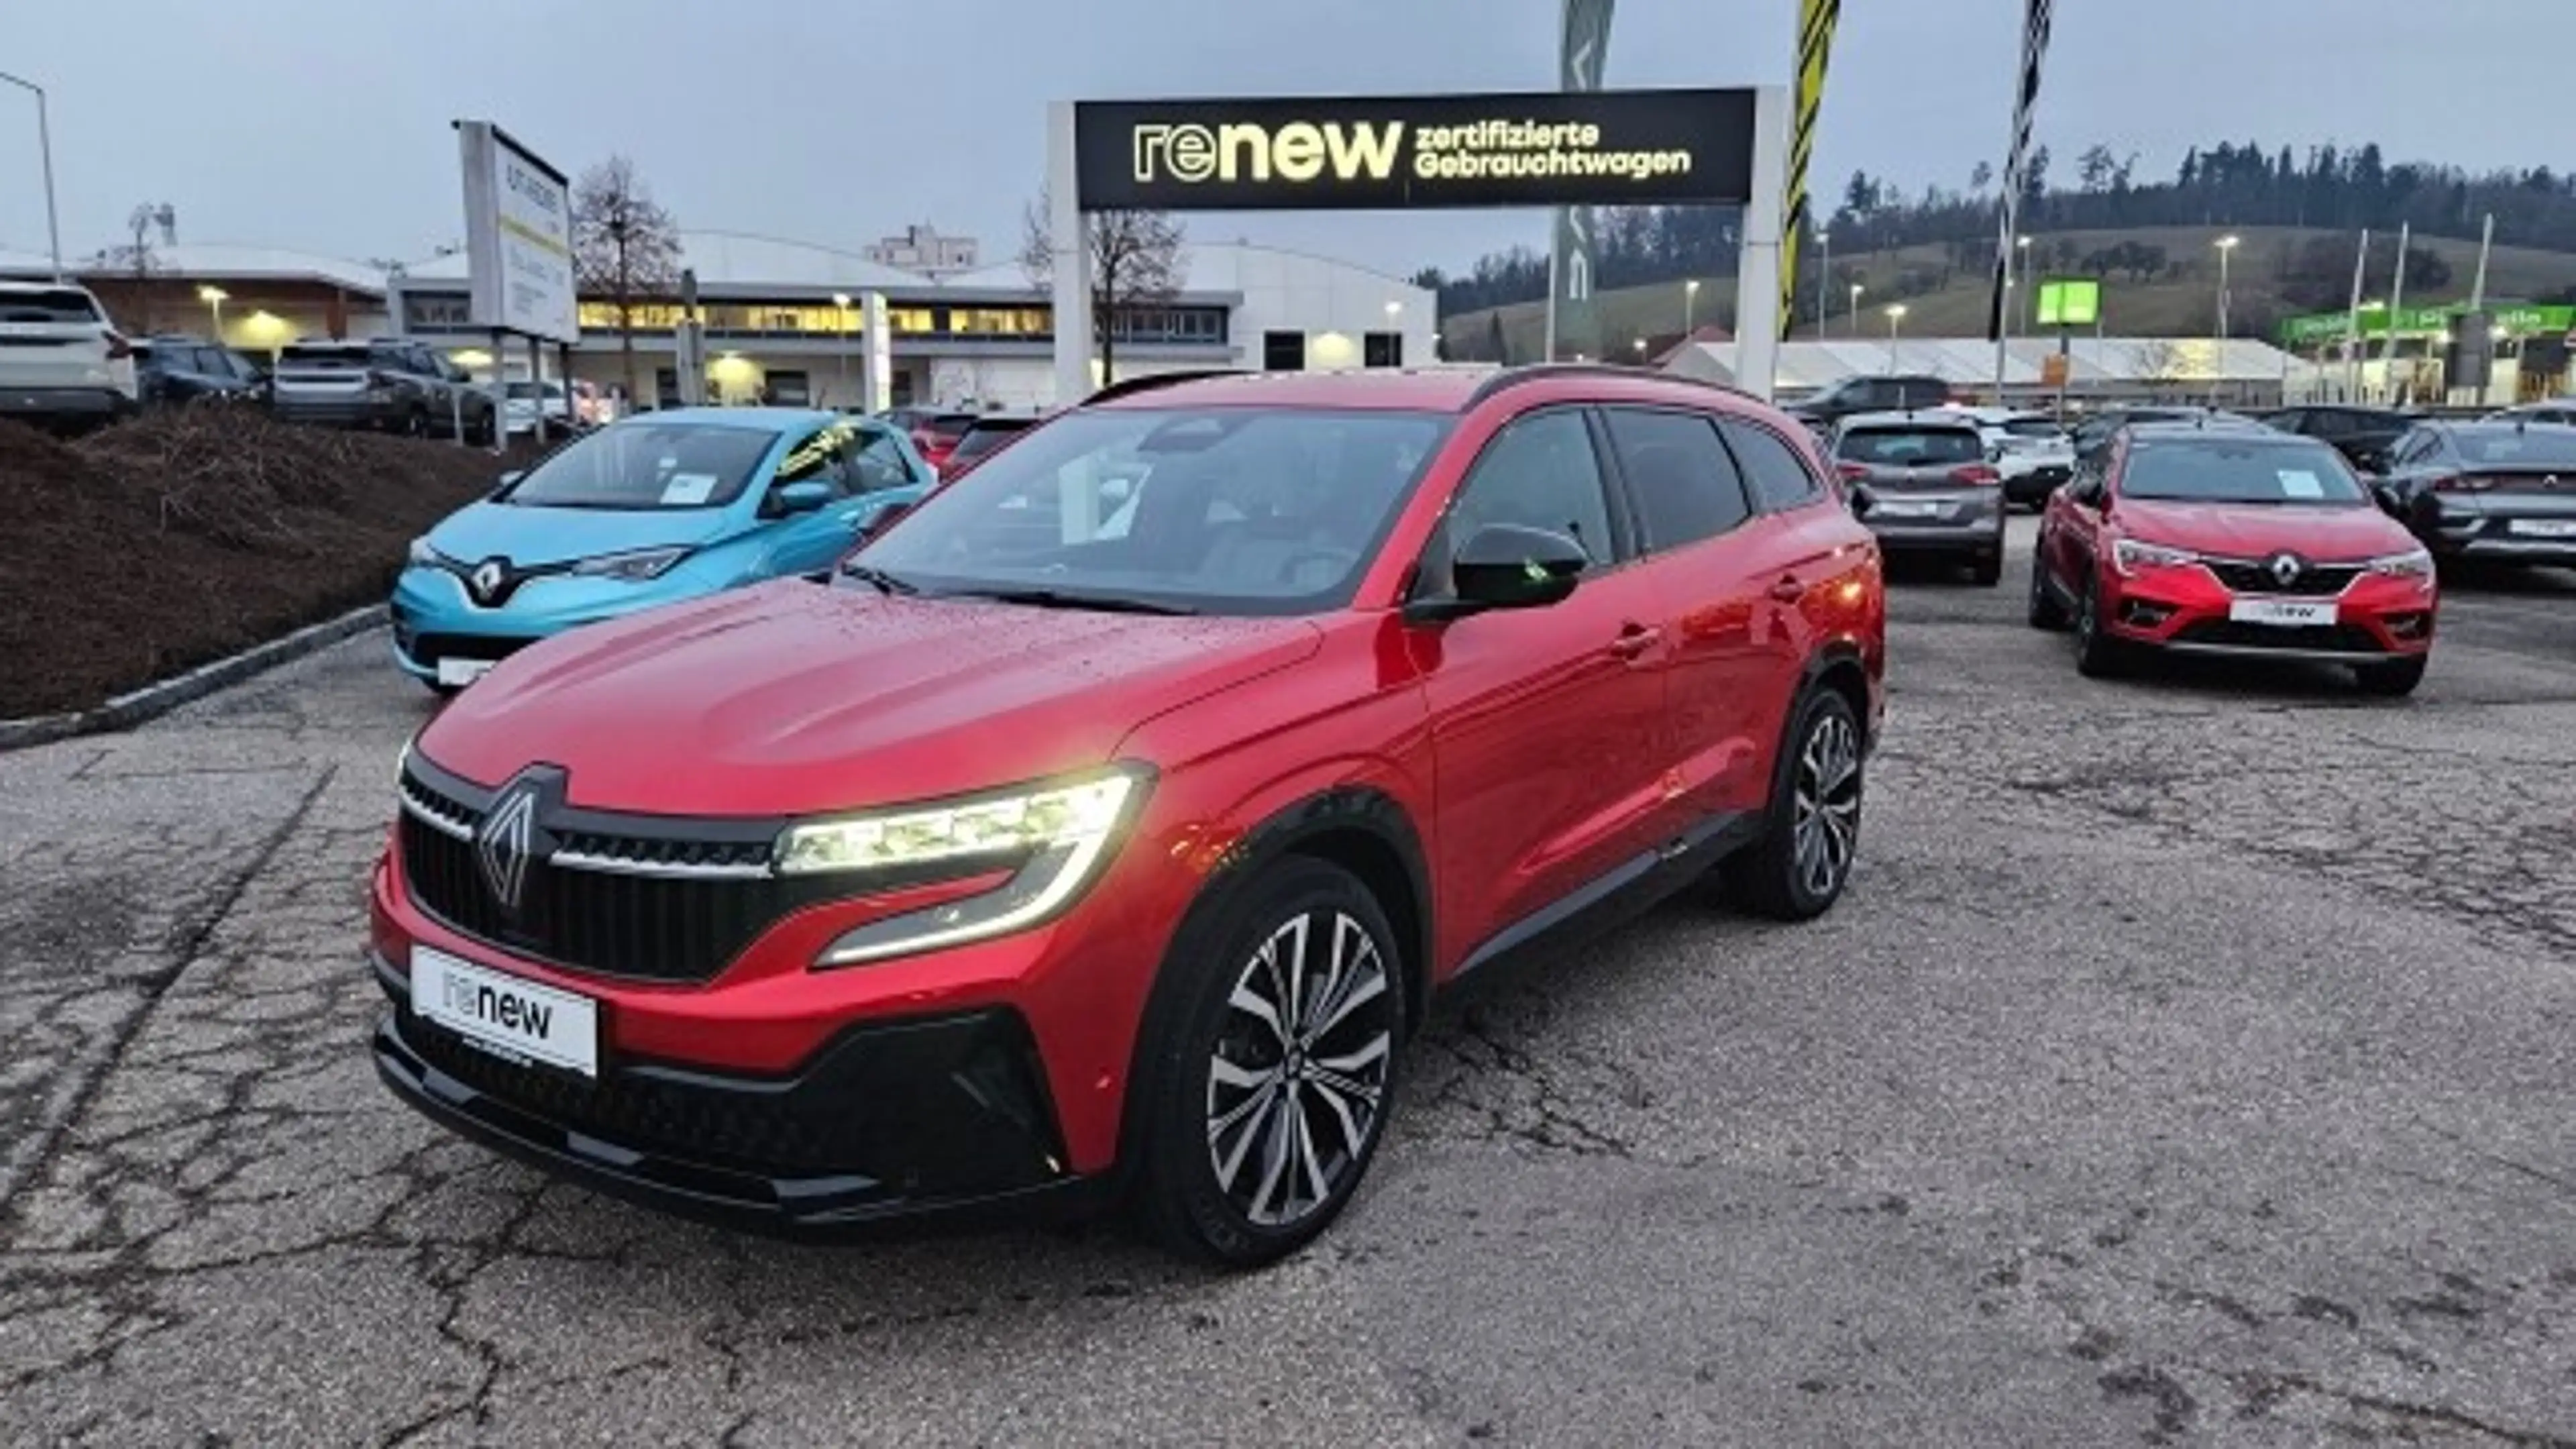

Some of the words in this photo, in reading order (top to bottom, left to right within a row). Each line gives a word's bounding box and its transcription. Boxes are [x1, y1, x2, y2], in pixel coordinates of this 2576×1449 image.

[1134, 121, 1405, 181] renew
[1415, 119, 1599, 150] zertifizierte
[1414, 148, 1692, 180] Gebrauchtwagen
[443, 970, 553, 1039] renew
